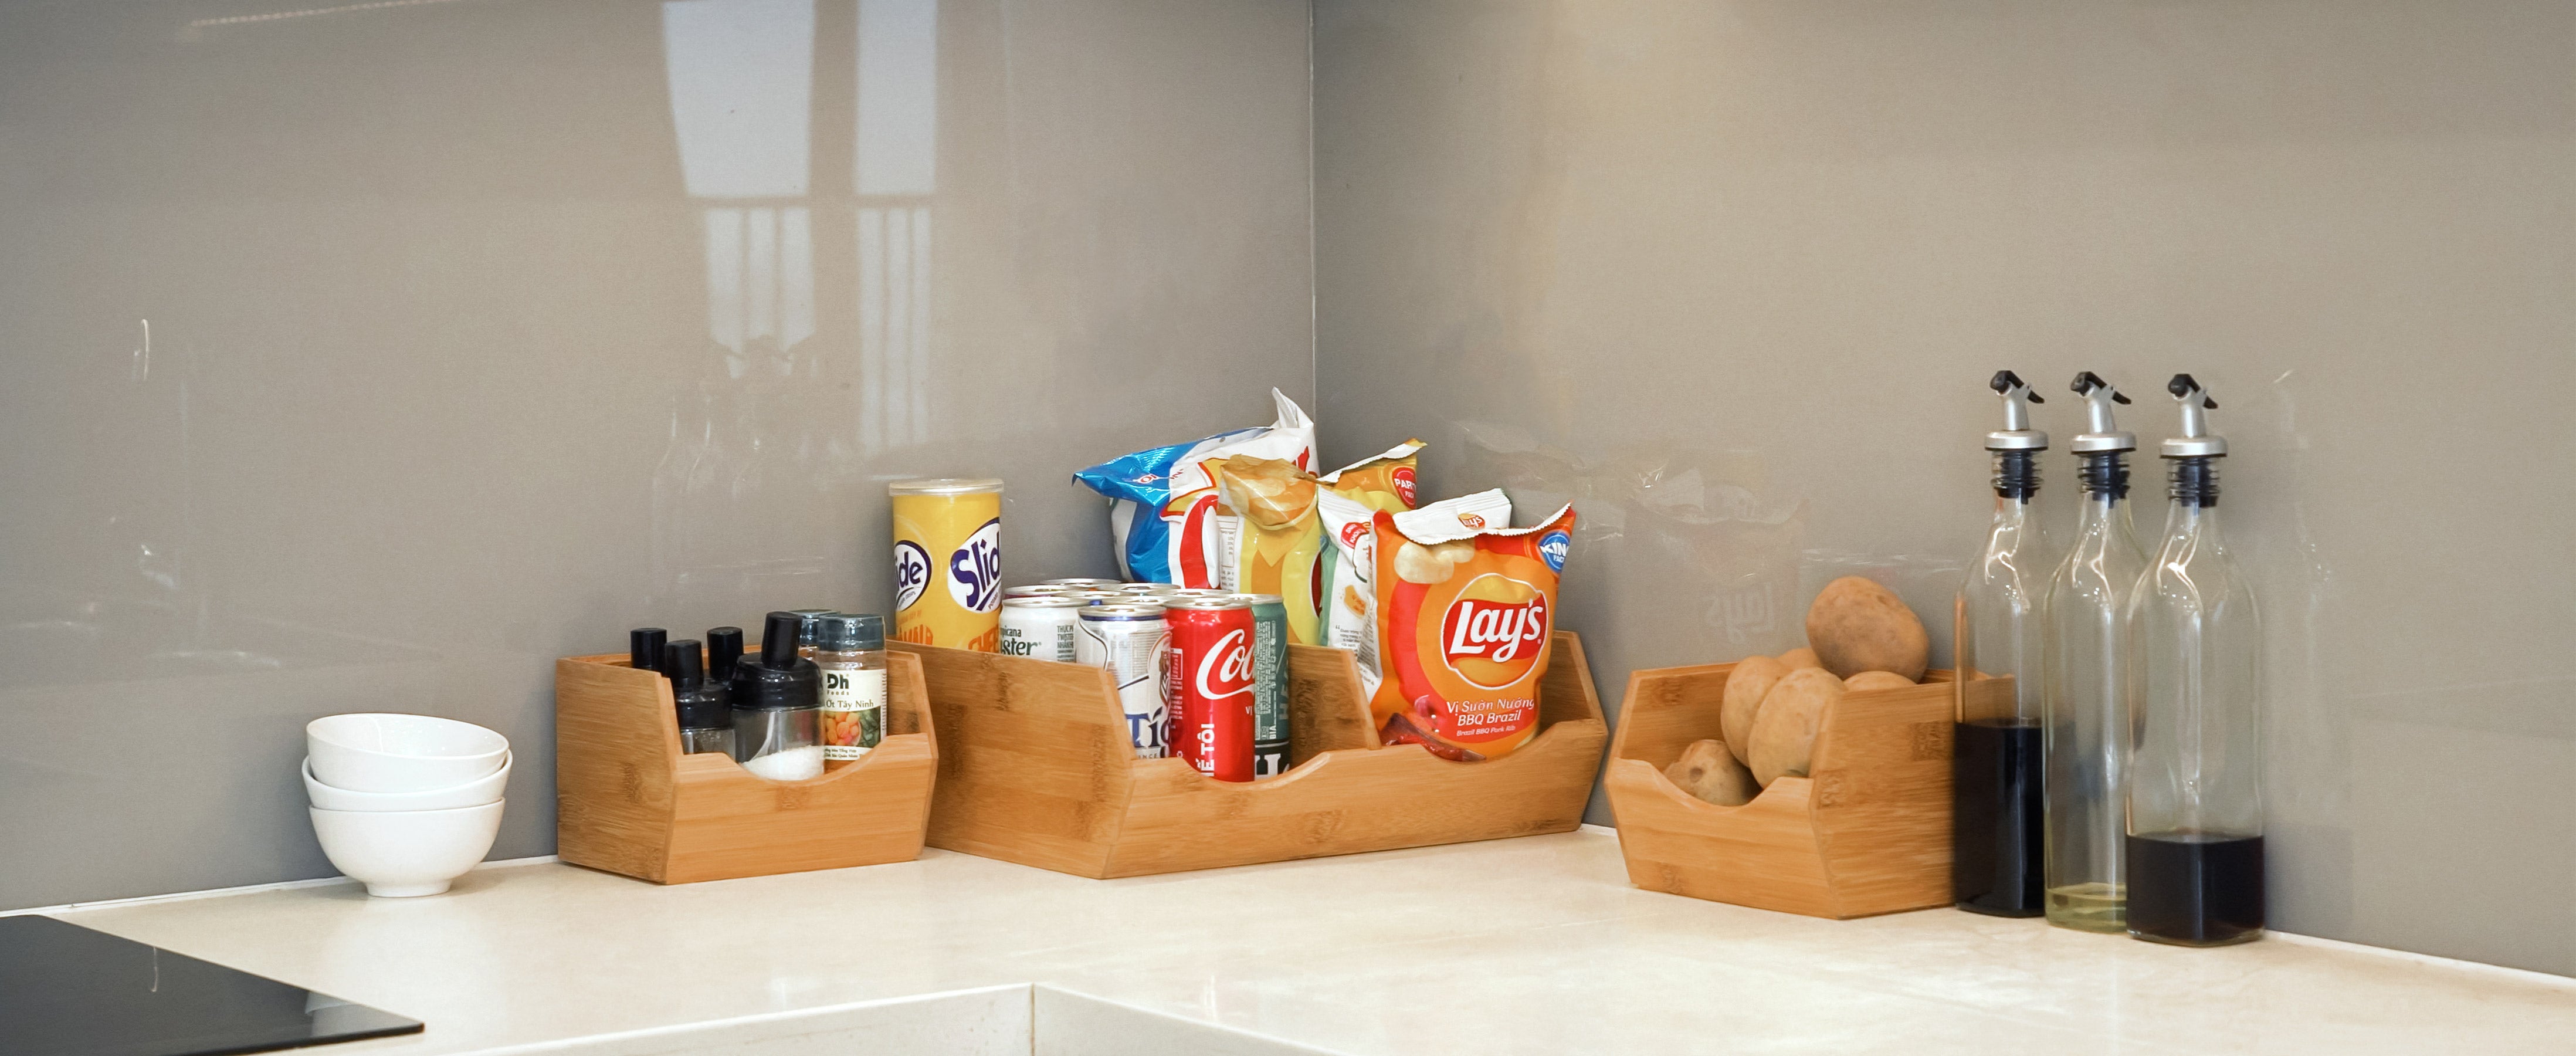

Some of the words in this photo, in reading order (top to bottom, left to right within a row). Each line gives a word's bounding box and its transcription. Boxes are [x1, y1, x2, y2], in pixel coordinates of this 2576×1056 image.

[1449, 598, 1543, 662] Lay's
[827, 673, 849, 689] Dh
[838, 700, 852, 710] Tây
[856, 699, 874, 708] Ninh
[1446, 700, 1459, 716] Vị
[1458, 713, 1484, 726] BBQ
[1487, 709, 1521, 723] Brazil
